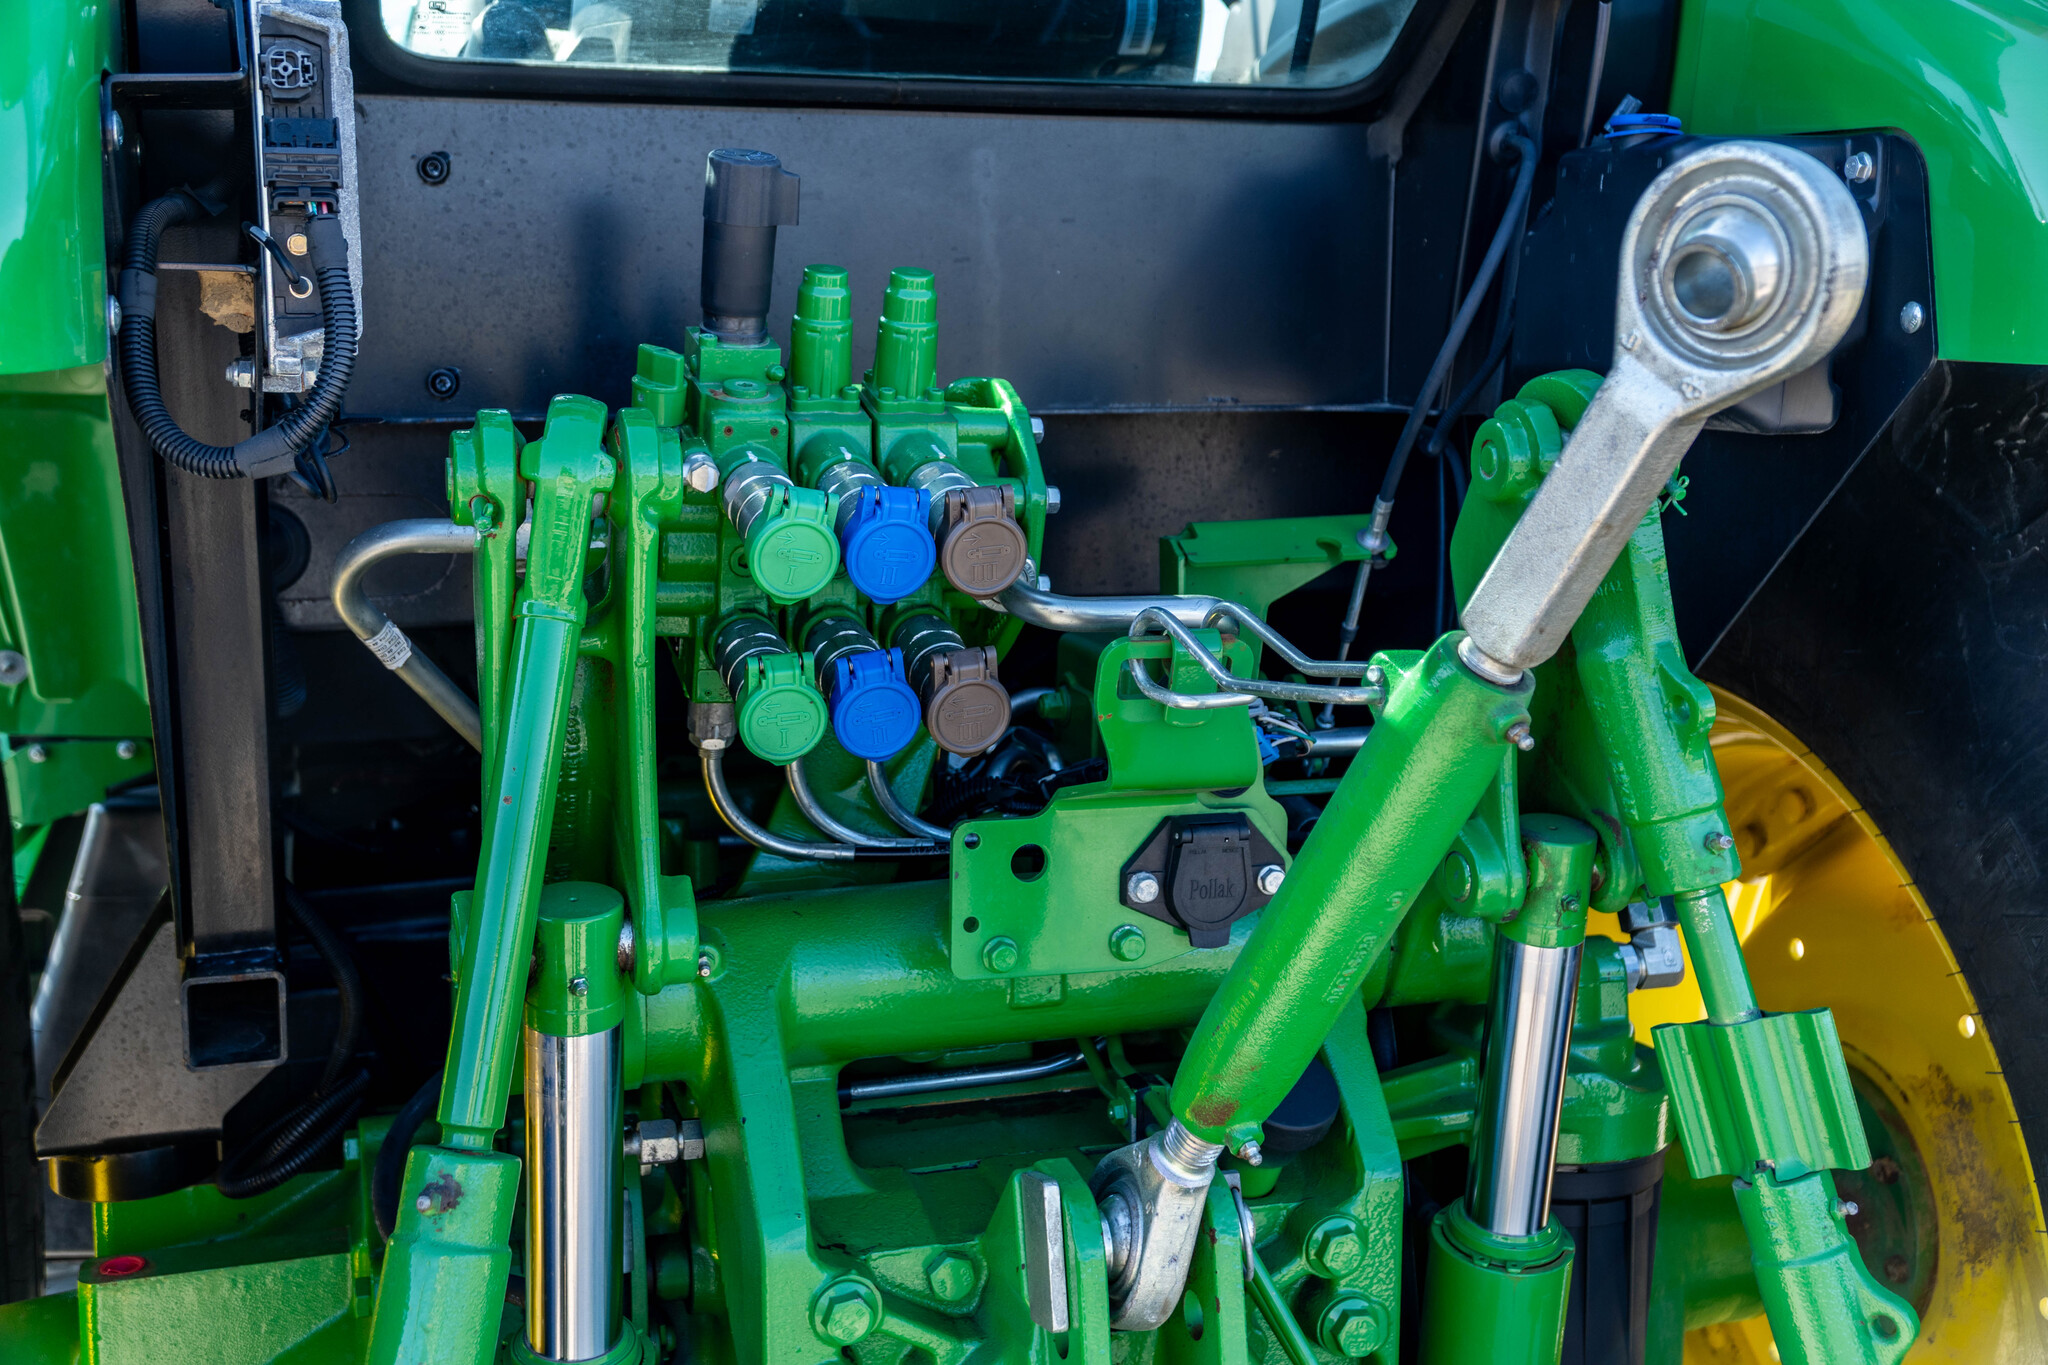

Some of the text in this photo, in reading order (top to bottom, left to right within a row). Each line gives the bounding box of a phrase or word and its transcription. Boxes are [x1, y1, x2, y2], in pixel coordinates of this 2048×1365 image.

[784, 565, 798, 586] I
[879, 566, 899, 586] II
[970, 562, 1000, 585] III
[780, 728, 788, 748] I
[871, 726, 889, 746] II
[957, 721, 985, 743] III
[1190, 877, 1236, 900] Pollak
